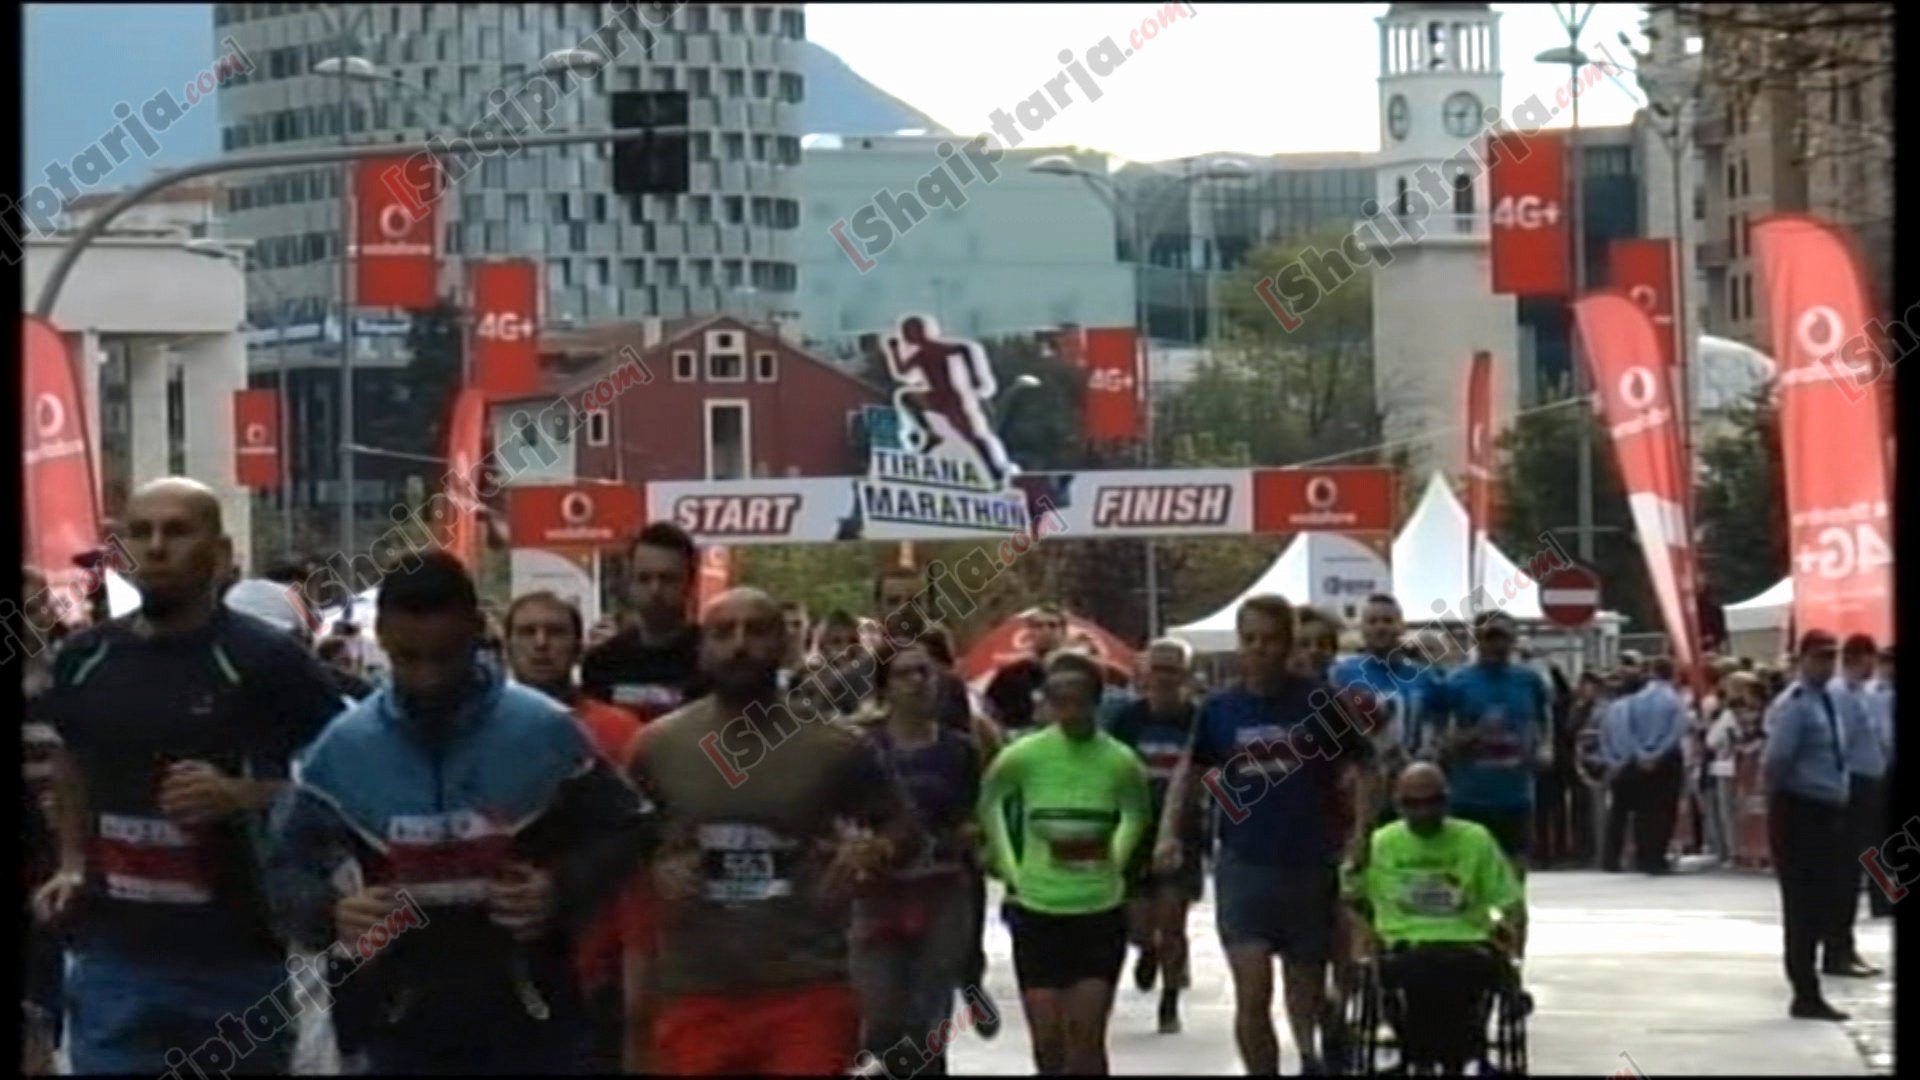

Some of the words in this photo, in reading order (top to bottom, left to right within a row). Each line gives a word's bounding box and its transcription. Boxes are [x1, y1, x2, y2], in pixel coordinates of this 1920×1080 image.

[1493, 196, 1561, 230] 4G+
[478, 312, 533, 341] 4G+
[876, 451, 982, 484] TIRANA
[673, 494, 801, 534] START
[865, 485, 1028, 530] MARATHON
[1094, 484, 1231, 526] FINISH
